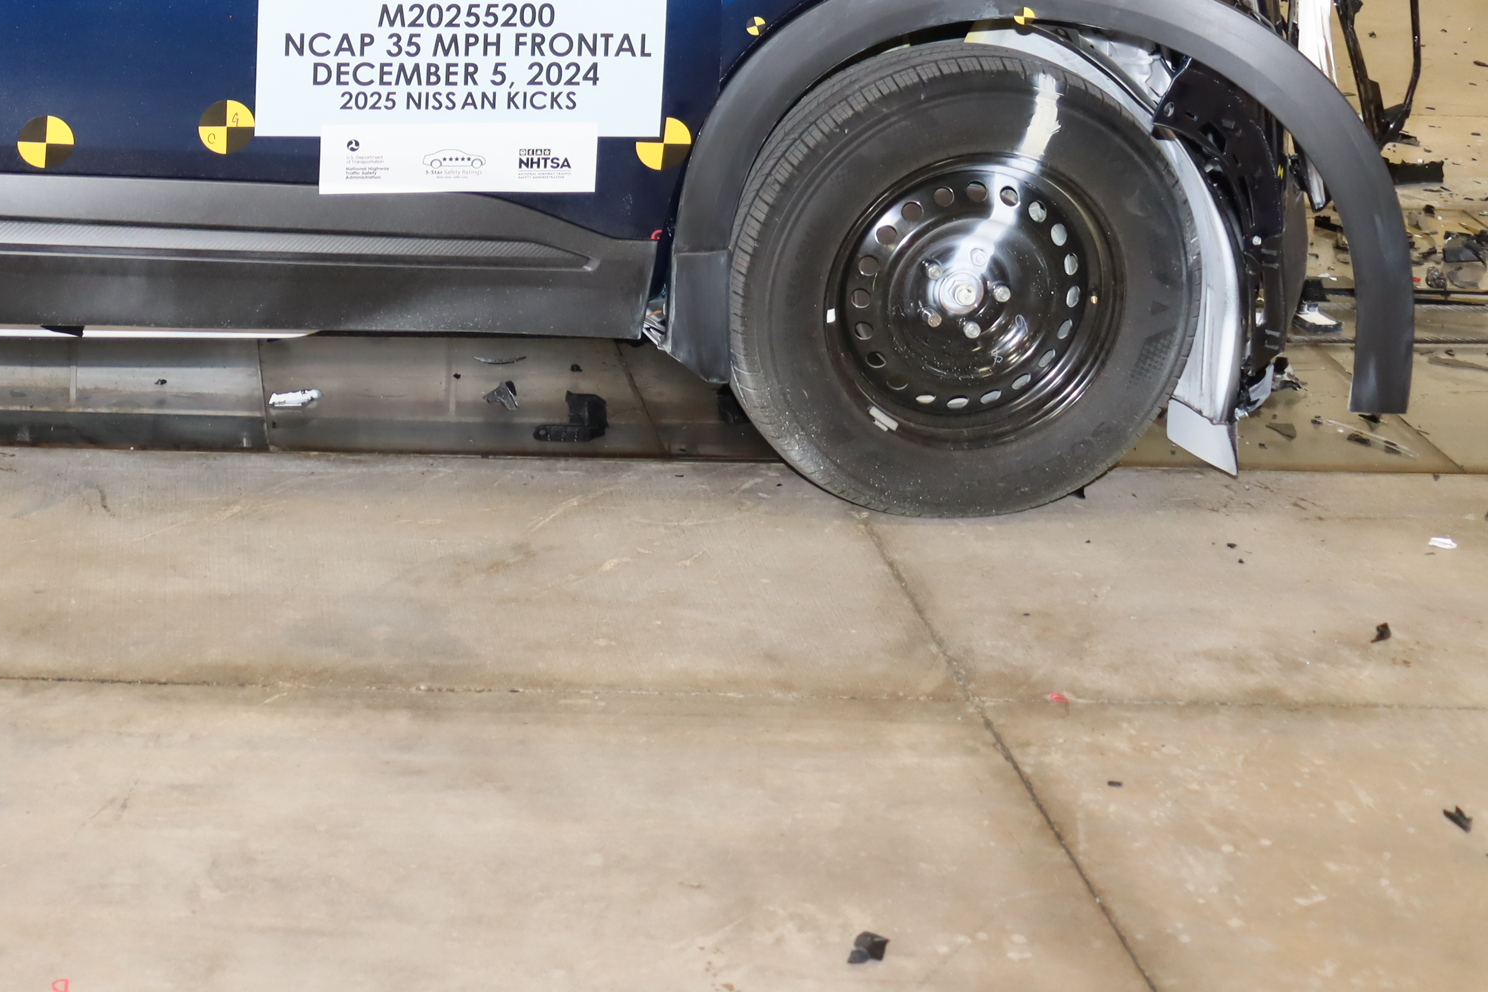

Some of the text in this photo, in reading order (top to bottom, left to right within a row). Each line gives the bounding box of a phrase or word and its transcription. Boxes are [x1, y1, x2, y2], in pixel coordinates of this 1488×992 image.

[378, 3, 555, 28] M20255200
[285, 33, 651, 57] NCAP 35 MPH FRONTAL
[313, 62, 599, 89] DECEMBER 5, 2024
[340, 91, 576, 110] 2025 NISSAN KICKS
[519, 155, 571, 169] NHTSA
